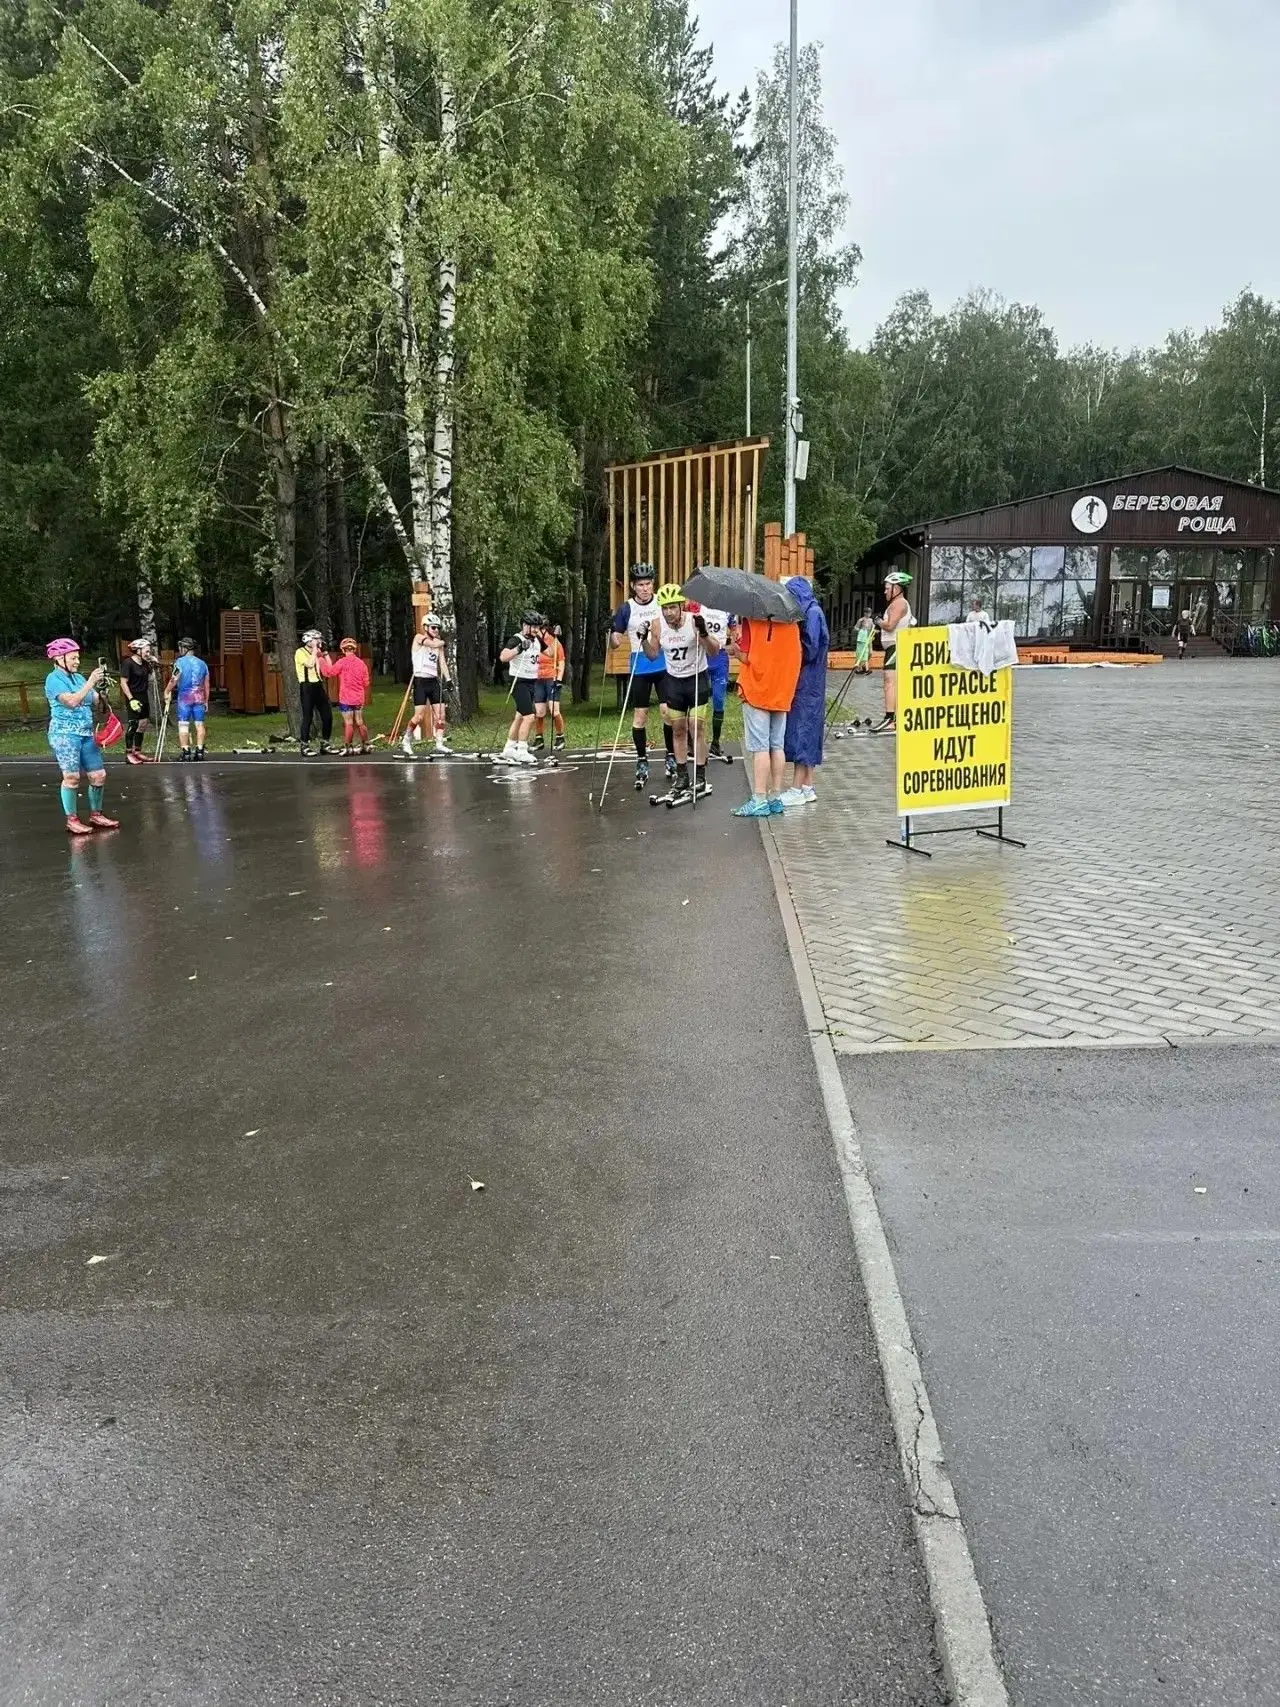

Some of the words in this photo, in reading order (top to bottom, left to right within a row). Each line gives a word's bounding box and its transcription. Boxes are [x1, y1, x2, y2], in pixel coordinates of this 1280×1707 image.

[1112, 495, 1223, 511] БЕРЕЗОВАЯ
[1178, 516, 1237, 534] РОЩА
[671, 646, 689, 661] 27
[912, 674, 935, 699] ПО
[940, 670, 998, 697] ТРАССЕ
[904, 700, 1006, 732] ЗАПРЕЩЕНО!
[933, 734, 977, 764] ИДУТ
[903, 763, 1006, 795] СОРЕВНОВАНИЯ
